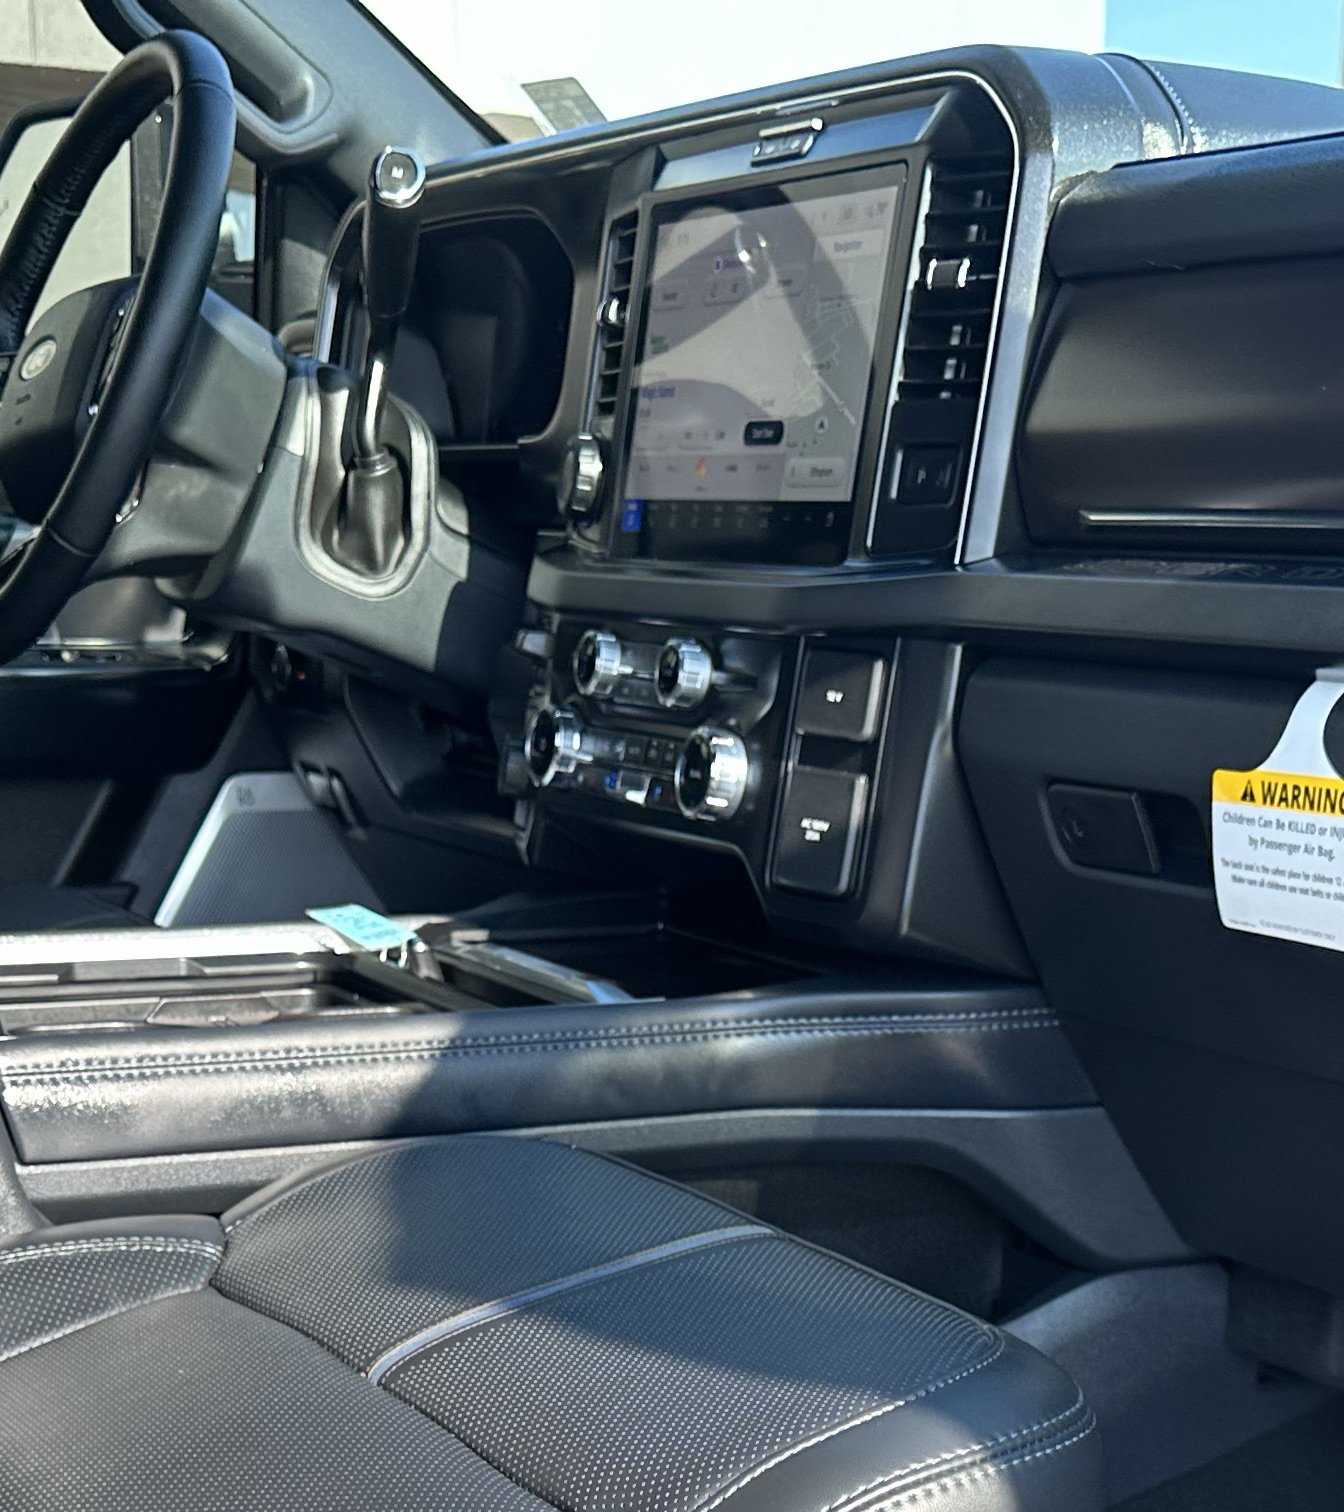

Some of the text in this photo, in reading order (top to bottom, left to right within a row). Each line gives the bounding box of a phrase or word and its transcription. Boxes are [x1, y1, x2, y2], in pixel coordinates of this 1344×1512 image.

[1222, 811, 1256, 826] Children
[1258, 815, 1274, 830] Can
[1275, 818, 1286, 831] Be
[1287, 820, 1317, 835] KILLED
[1318, 826, 1328, 836] or
[1248, 834, 1259, 848] by
[1260, 836, 1302, 856] Passenger
[1303, 842, 1316, 854] Air
